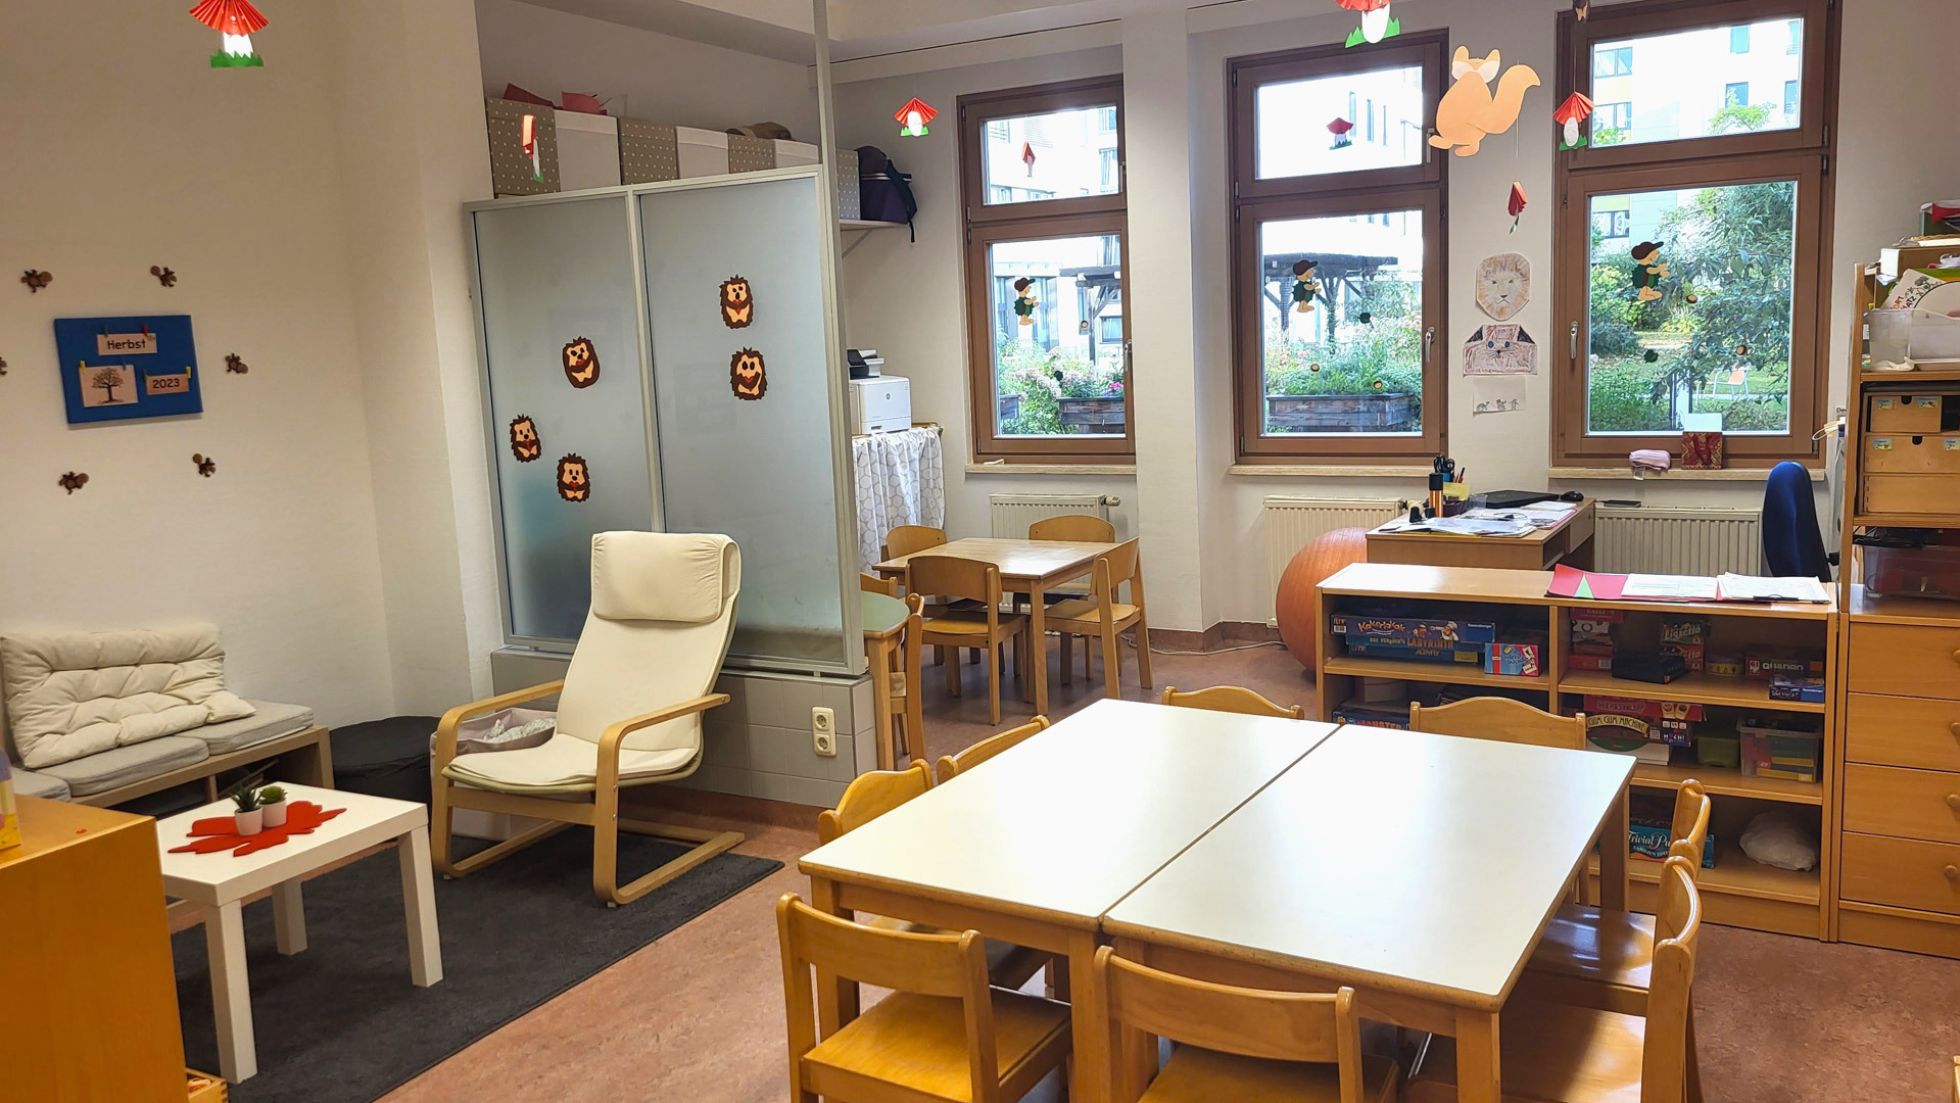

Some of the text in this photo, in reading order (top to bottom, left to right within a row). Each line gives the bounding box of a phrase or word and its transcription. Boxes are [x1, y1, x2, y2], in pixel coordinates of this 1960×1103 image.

[107, 339, 146, 350] Herbst
[152, 378, 181, 389] 2023
[1628, 831, 1654, 845] Trivial
